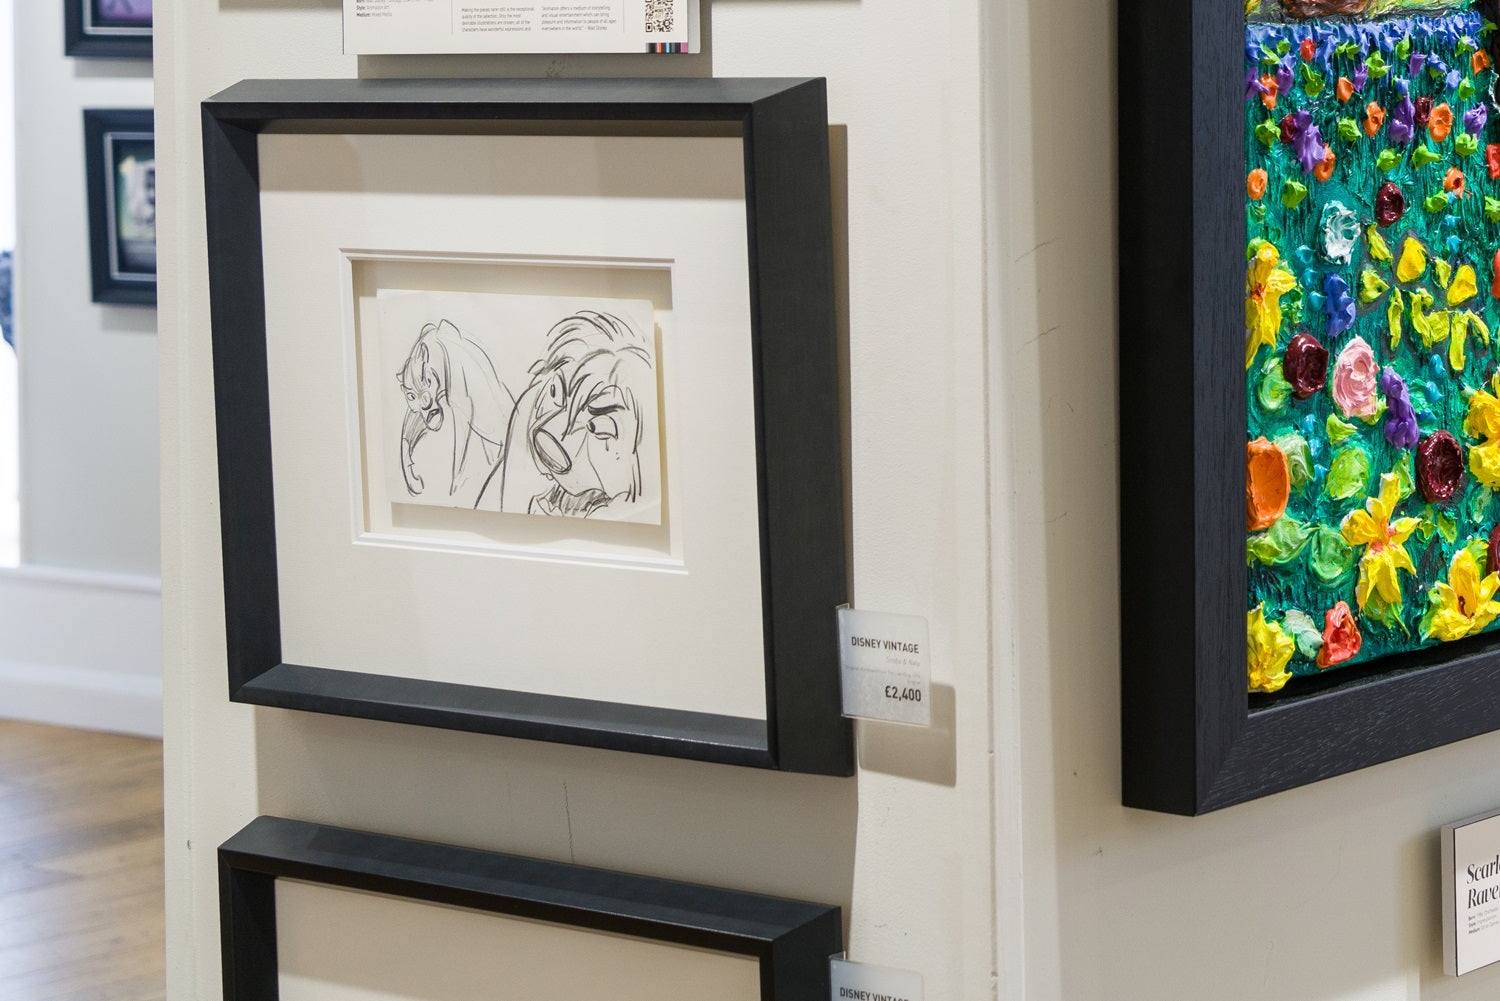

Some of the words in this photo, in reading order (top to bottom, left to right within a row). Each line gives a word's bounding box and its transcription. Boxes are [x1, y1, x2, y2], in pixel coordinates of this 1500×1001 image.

[852, 636, 881, 649] DISNEY
[883, 642, 919, 654] VINTAGE
[885, 685, 922, 702] £2,400
[840, 987, 871, 1000] DISNEY
[872, 993, 910, 1001] VINTA
